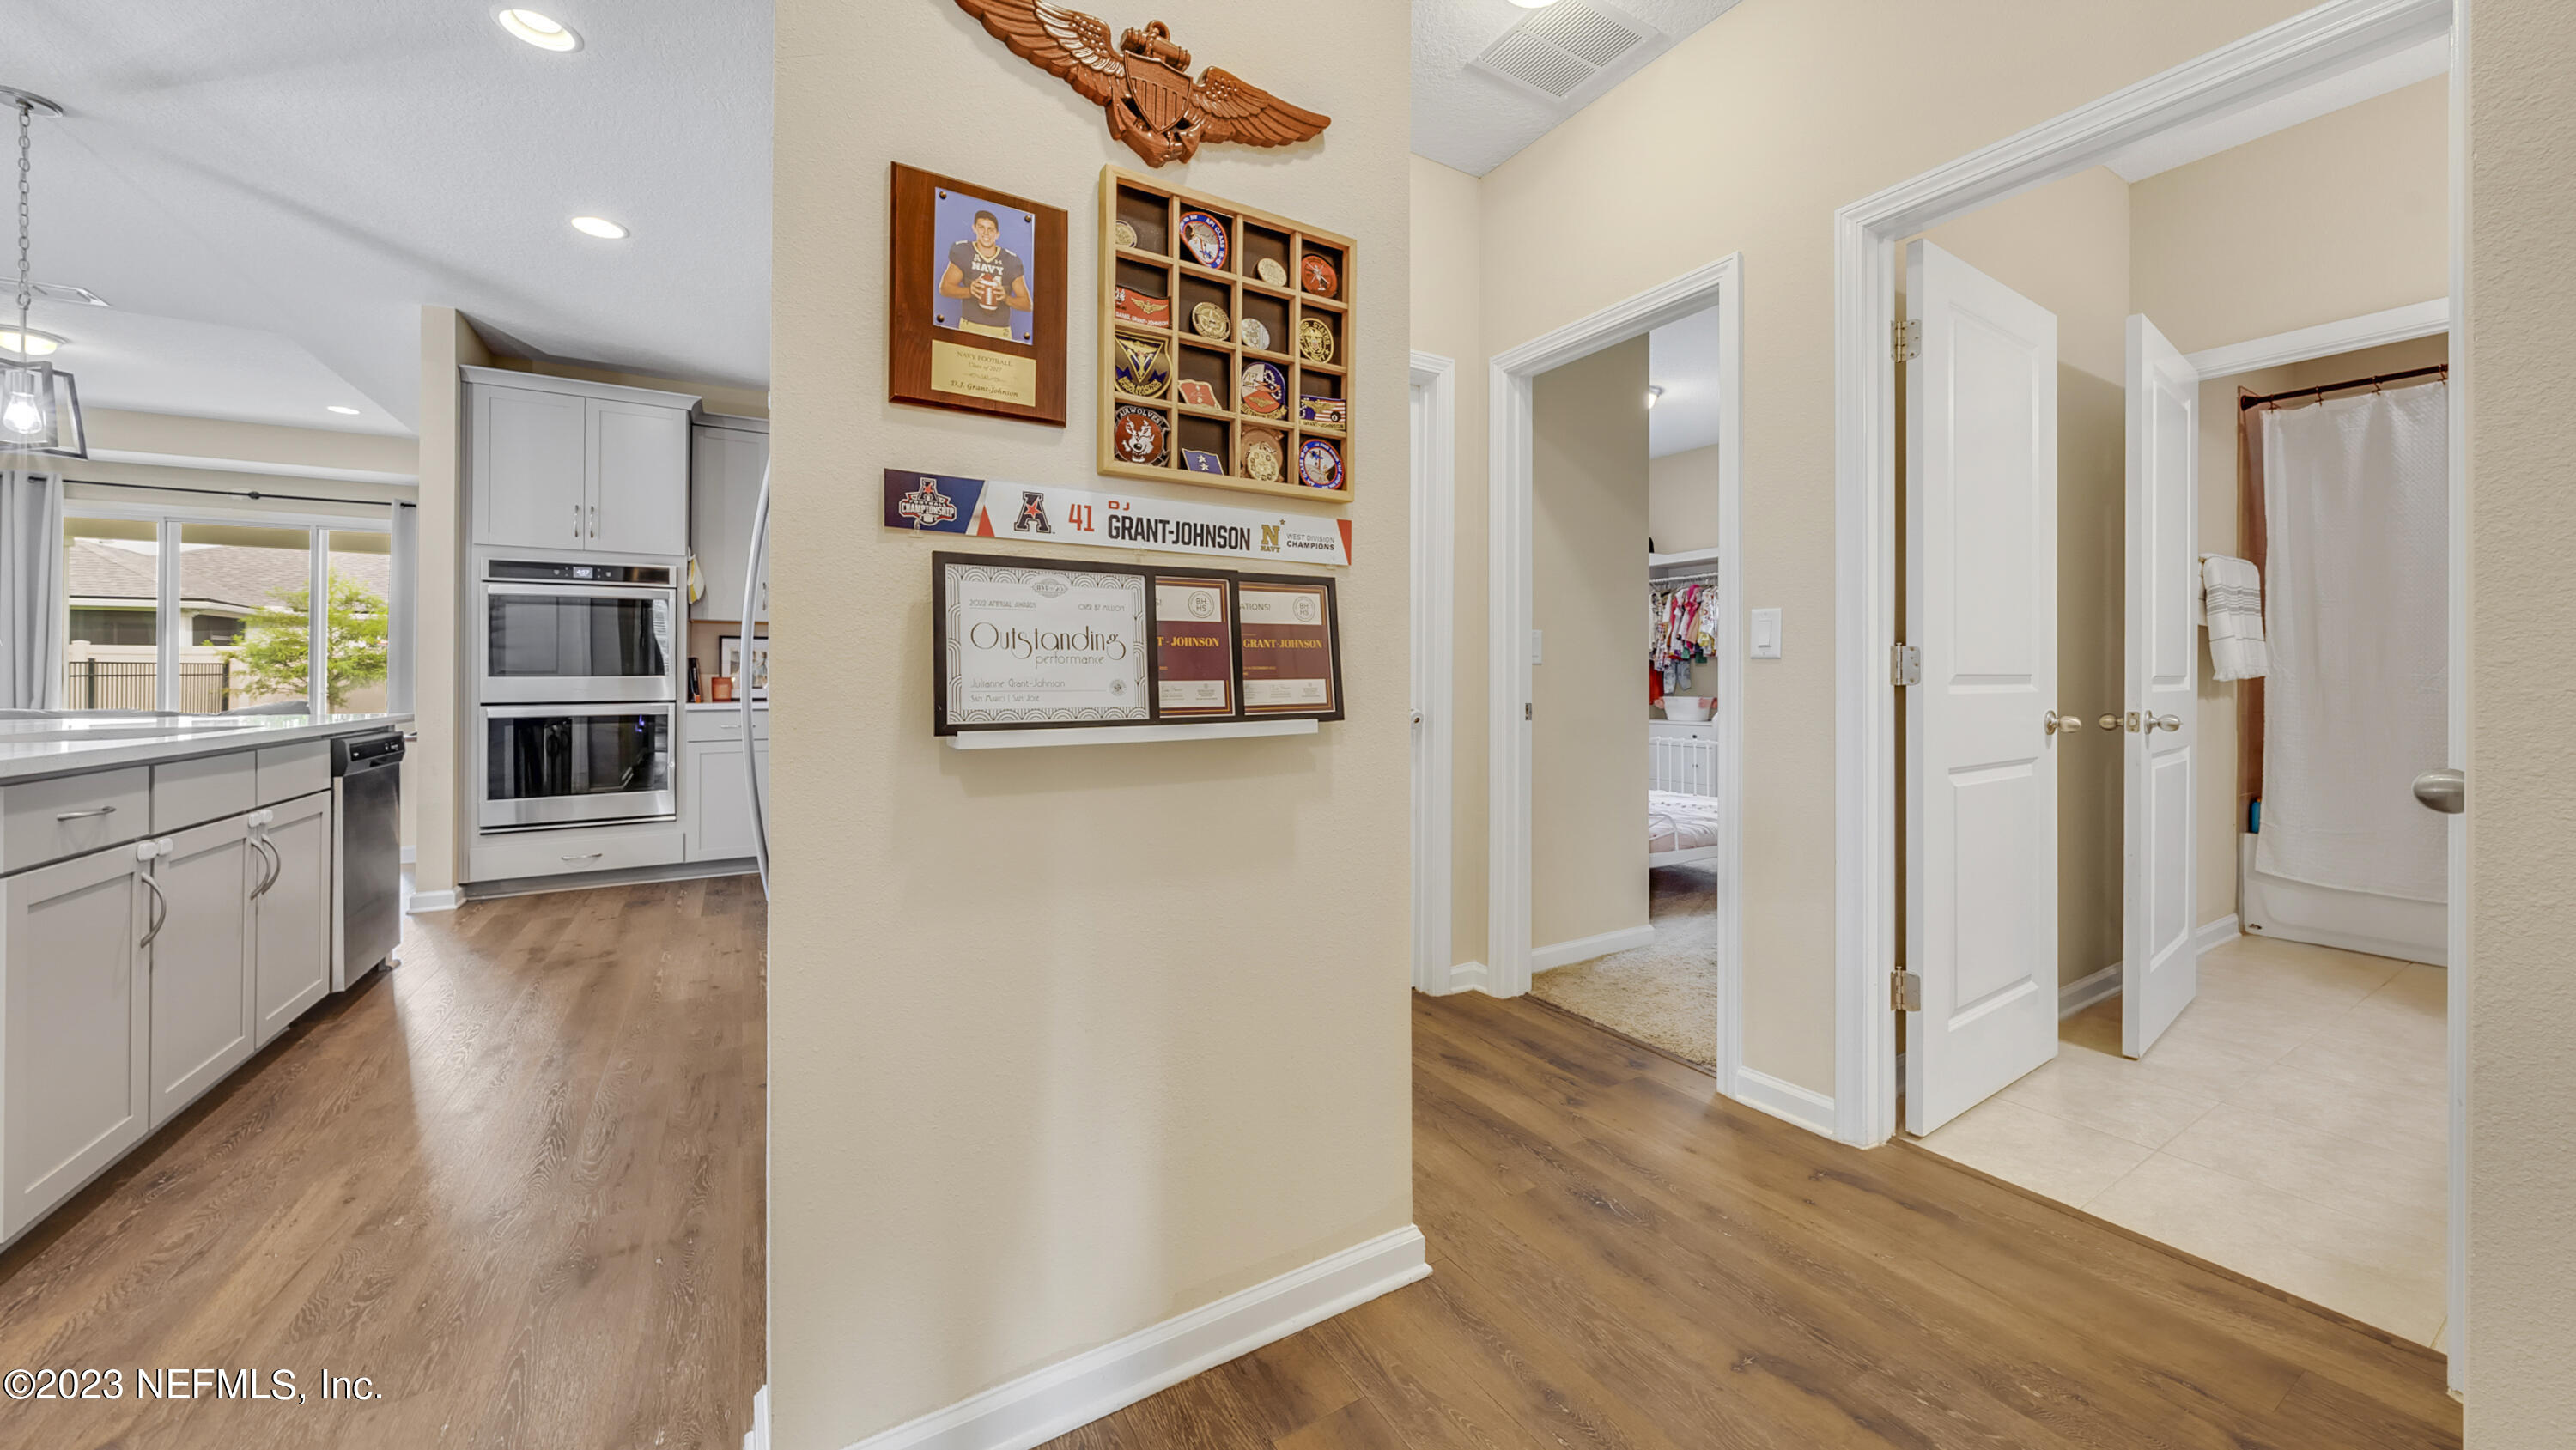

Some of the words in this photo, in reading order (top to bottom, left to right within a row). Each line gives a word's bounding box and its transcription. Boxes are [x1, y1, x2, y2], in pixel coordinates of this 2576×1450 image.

[971, 260, 1004, 276] NAVY
[957, 350, 976, 361] NAVY
[977, 355, 1013, 367] FOOTBALL
[968, 361, 982, 370] Class
[966, 383, 1018, 397] Grant-Johnson
[1119, 407, 1161, 424] AIRWOLVES
[901, 501, 955, 517] CHAMPIONSHIP
[909, 499, 948, 508] FOOTBALL
[1068, 503, 1095, 532] 41
[1108, 514, 1250, 551] GRANT-JOHNSON
[1287, 533, 1305, 542] WEST
[1306, 534, 1334, 543] DIVISION
[1260, 544, 1281, 554] NAVY
[1286, 540, 1335, 551] CHAMPIONS
[970, 622, 1127, 661] Outstanding
[1243, 639, 1323, 649] GRANT-JOHNSON
[1036, 650, 1105, 670] performance
[970, 678, 1005, 689] Julianne
[1008, 677, 1066, 688] Grant-Johnson
